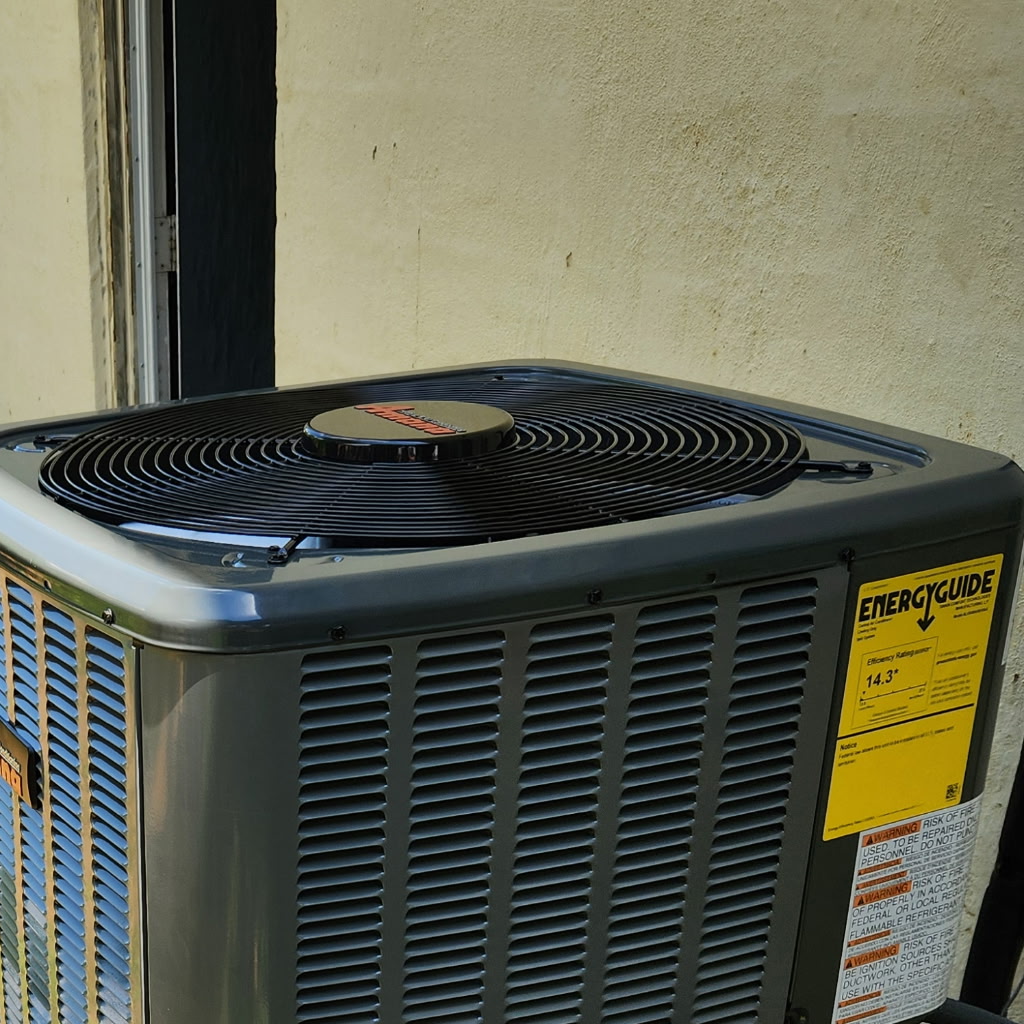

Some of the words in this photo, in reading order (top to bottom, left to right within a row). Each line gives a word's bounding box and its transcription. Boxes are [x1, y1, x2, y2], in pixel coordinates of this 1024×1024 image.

[858, 569, 995, 623] ENERGYGUIDE
[867, 655, 895, 666] Efficiency
[896, 650, 915, 658] Rating
[840, 742, 857, 751] Notice
[875, 823, 917, 844] WARNING
[923, 815, 944, 829] RISK
[946, 811, 958, 822] OF
[893, 838, 906, 848] TO
[908, 834, 919, 845] BE
[922, 820, 965, 840] REPAIRED
[921, 840, 934, 851] DO
[936, 834, 955, 846] NOT
[865, 883, 908, 903] WARNING
[913, 876, 933, 889] RISK
[935, 872, 947, 883] OF
[851, 910, 892, 928] FEDERAL
[896, 904, 909, 915] OR
[911, 896, 938, 911] LOCAL
[852, 907, 865, 918] OF
[868, 891, 916, 912] PROPERLY
[917, 888, 926, 898] IN
[849, 917, 903, 940] FLAMMABLE
[845, 969, 857, 979] BE
[860, 956, 898, 974] IGNITION
[900, 942, 942, 962] SOURCES
[854, 946, 897, 967] WARNING
[903, 940, 924, 952] RISK
[926, 934, 938, 945] OF
[900, 956, 930, 972] OTHER
[841, 988, 860, 1000] USE
[862, 980, 885, 994] WITH
[888, 974, 904, 986] THE
